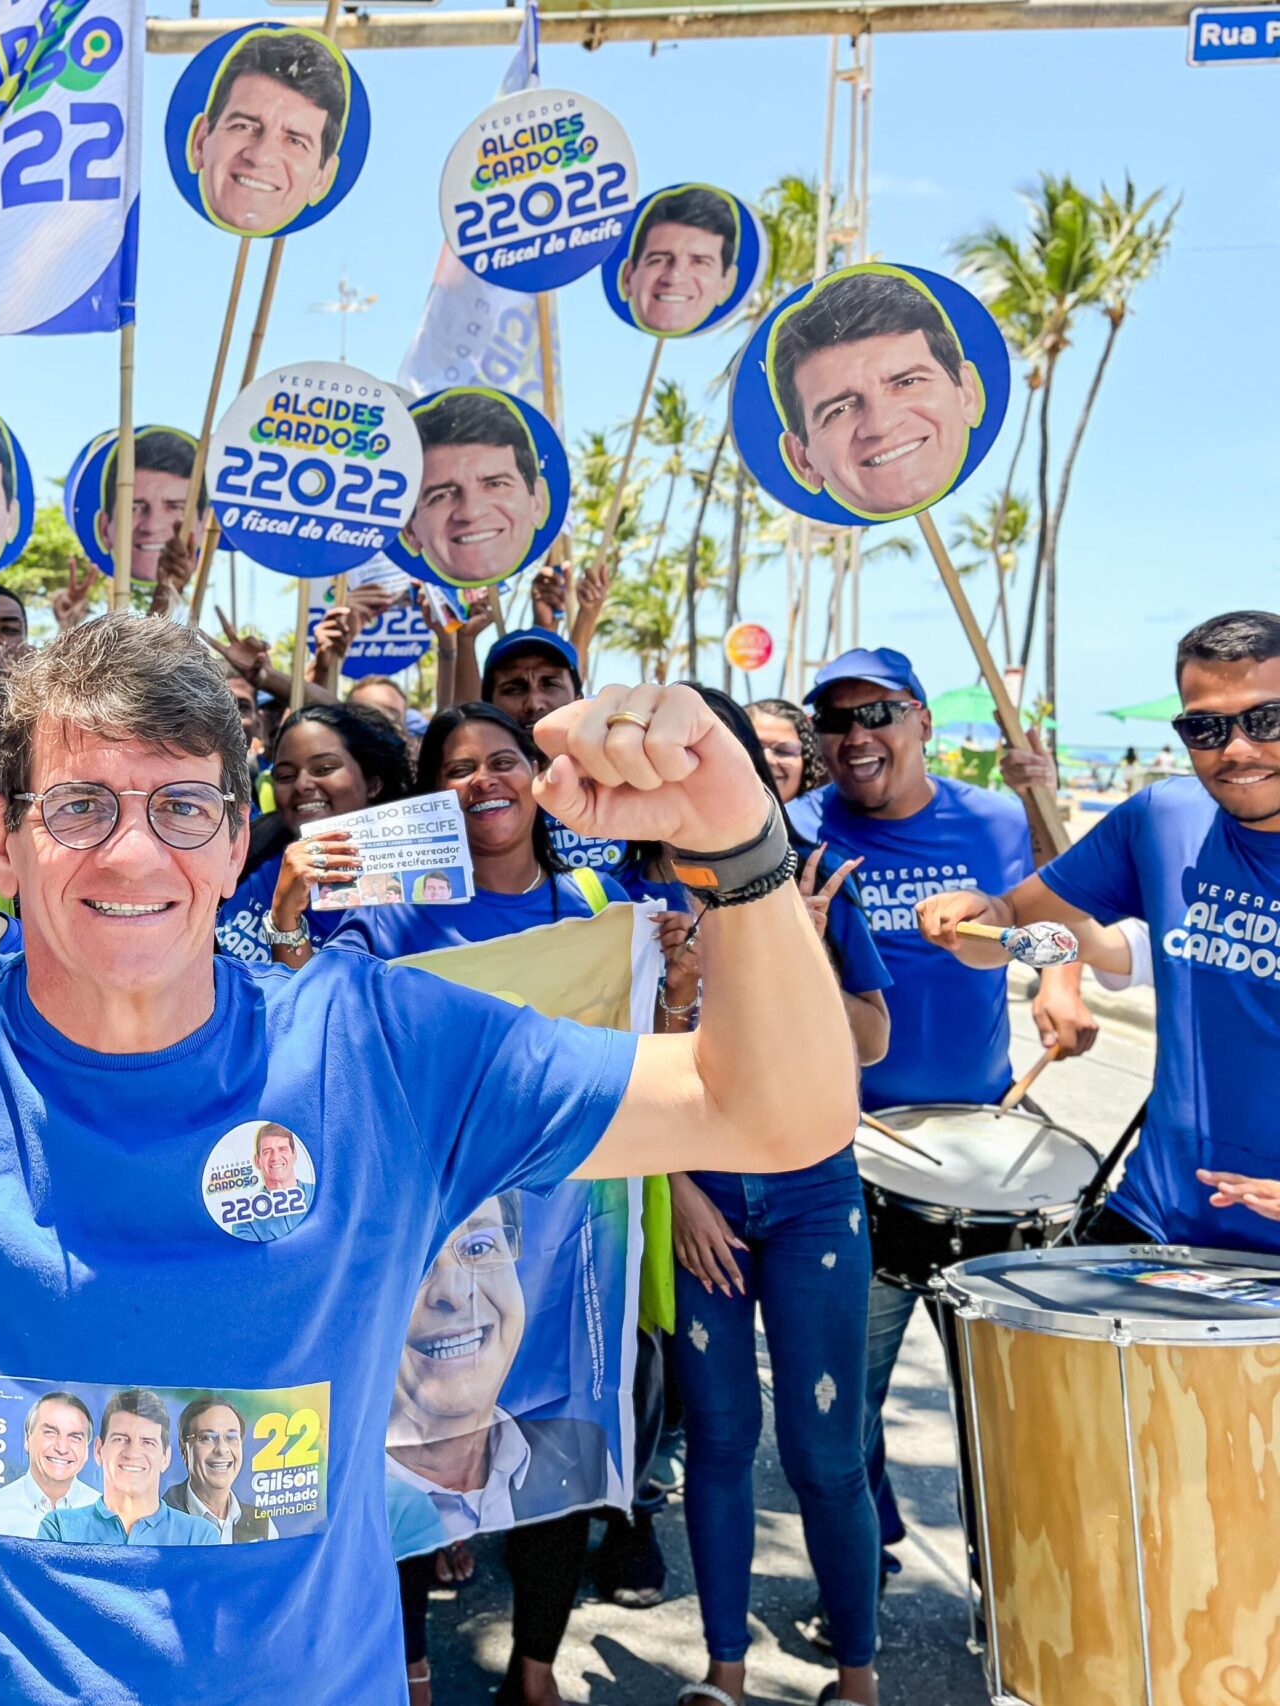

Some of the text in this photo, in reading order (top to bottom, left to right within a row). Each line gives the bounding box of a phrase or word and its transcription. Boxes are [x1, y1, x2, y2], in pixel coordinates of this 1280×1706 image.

[1200, 22, 1257, 47] Rua
[479, 98, 576, 132] VEREADOR
[482, 112, 585, 159] ALCIDES
[475, 135, 598, 185] CARDOSO
[454, 162, 629, 247] 22022
[474, 218, 622, 273] O fiscal do Recife
[278, 374, 382, 399] VEREADOR
[272, 392, 385, 427] ALCIDES
[257, 416, 391, 456] CARDOSO
[215, 445, 408, 520] 22022
[222, 507, 384, 549] O fiscal do Recife
[377, 808, 399, 820] DO
[402, 799, 452, 816] RECIFE
[382, 825, 404, 837] DO
[407, 819, 458, 835] RECIFE
[366, 862, 394, 872] pelos
[397, 855, 457, 868] recifenses?
[369, 846, 461, 862] quem é o vereador
[858, 864, 968, 881] VEREADOR
[1183, 901, 1280, 948] ALCID
[1163, 928, 1280, 981] CARDO
[207, 1175, 259, 1193] CARDOSO
[211, 1165, 253, 1182] ALCIDES
[221, 1189, 305, 1224] 22022
[252, 1408, 321, 1472] 22
[251, 1469, 318, 1493] Gilson
[255, 1487, 318, 1507] Machado
[254, 1502, 317, 1519] Leninha Dias
